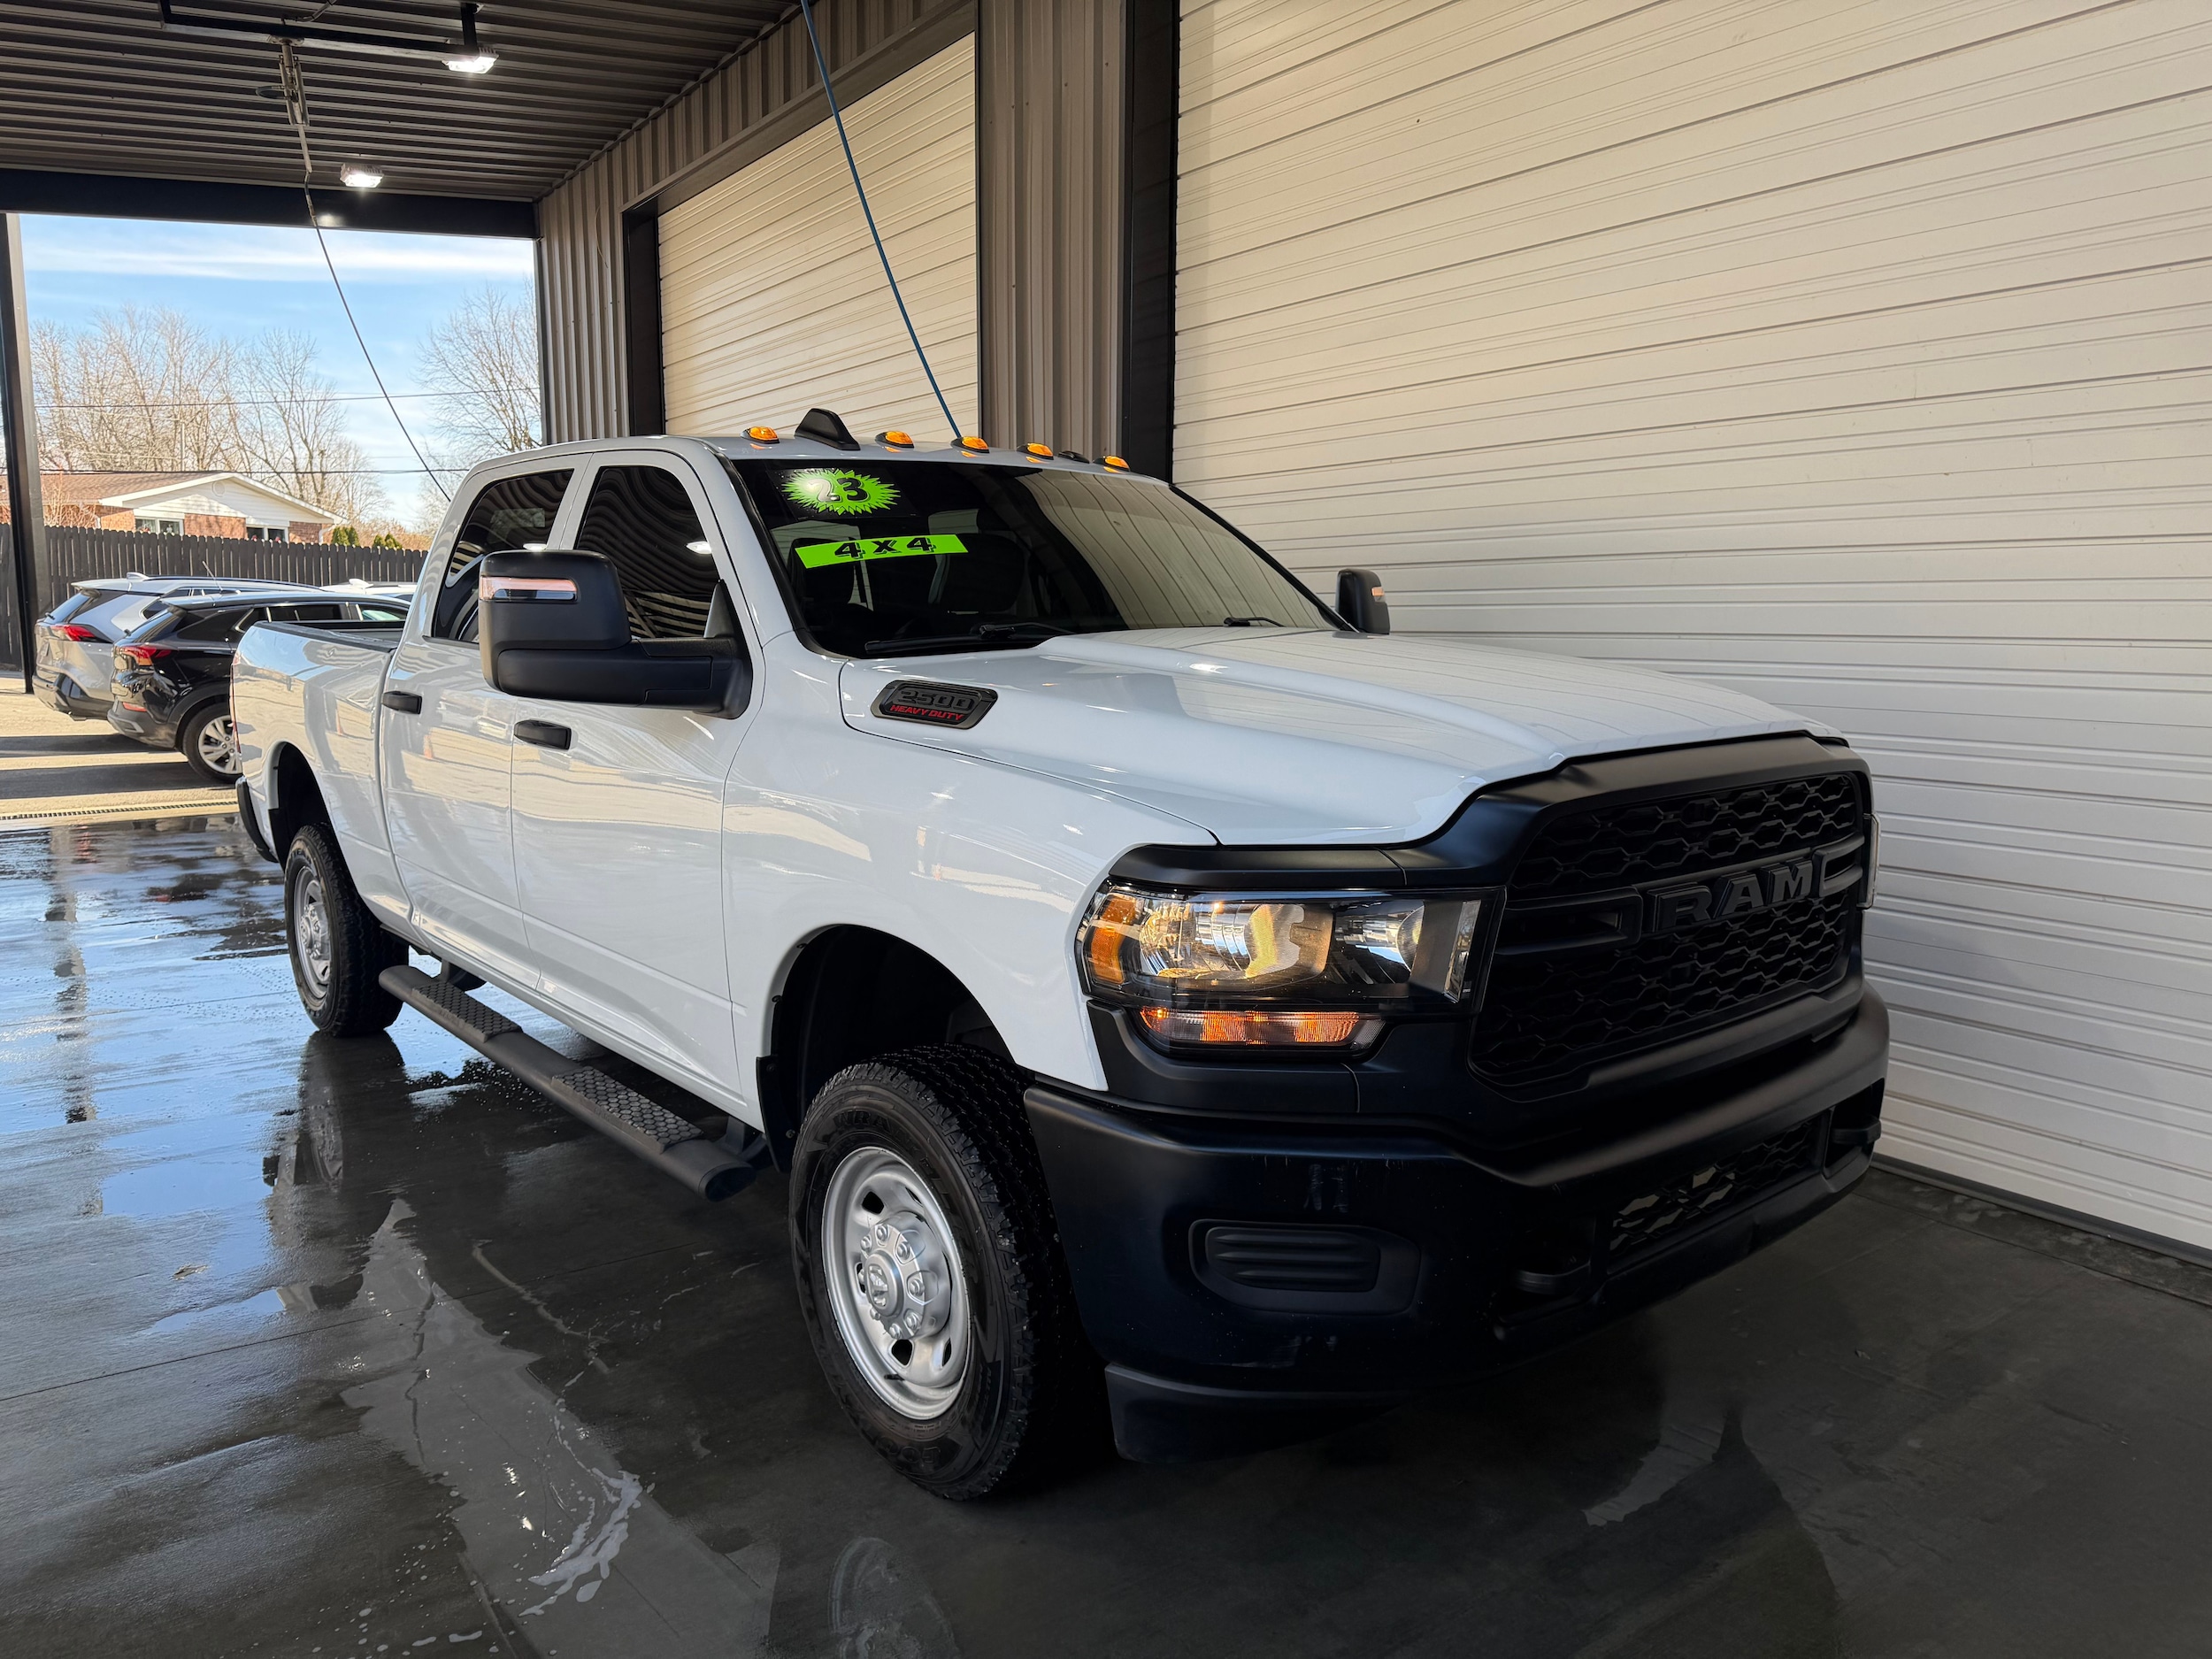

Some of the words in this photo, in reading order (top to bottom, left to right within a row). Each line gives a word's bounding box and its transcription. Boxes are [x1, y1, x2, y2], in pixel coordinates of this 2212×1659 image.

[807, 478, 870, 503] 23
[896, 690, 974, 710] 2500
[889, 704, 929, 716] HEAVY
[928, 709, 965, 721] DUTY
[1647, 856, 1814, 933] RAM
